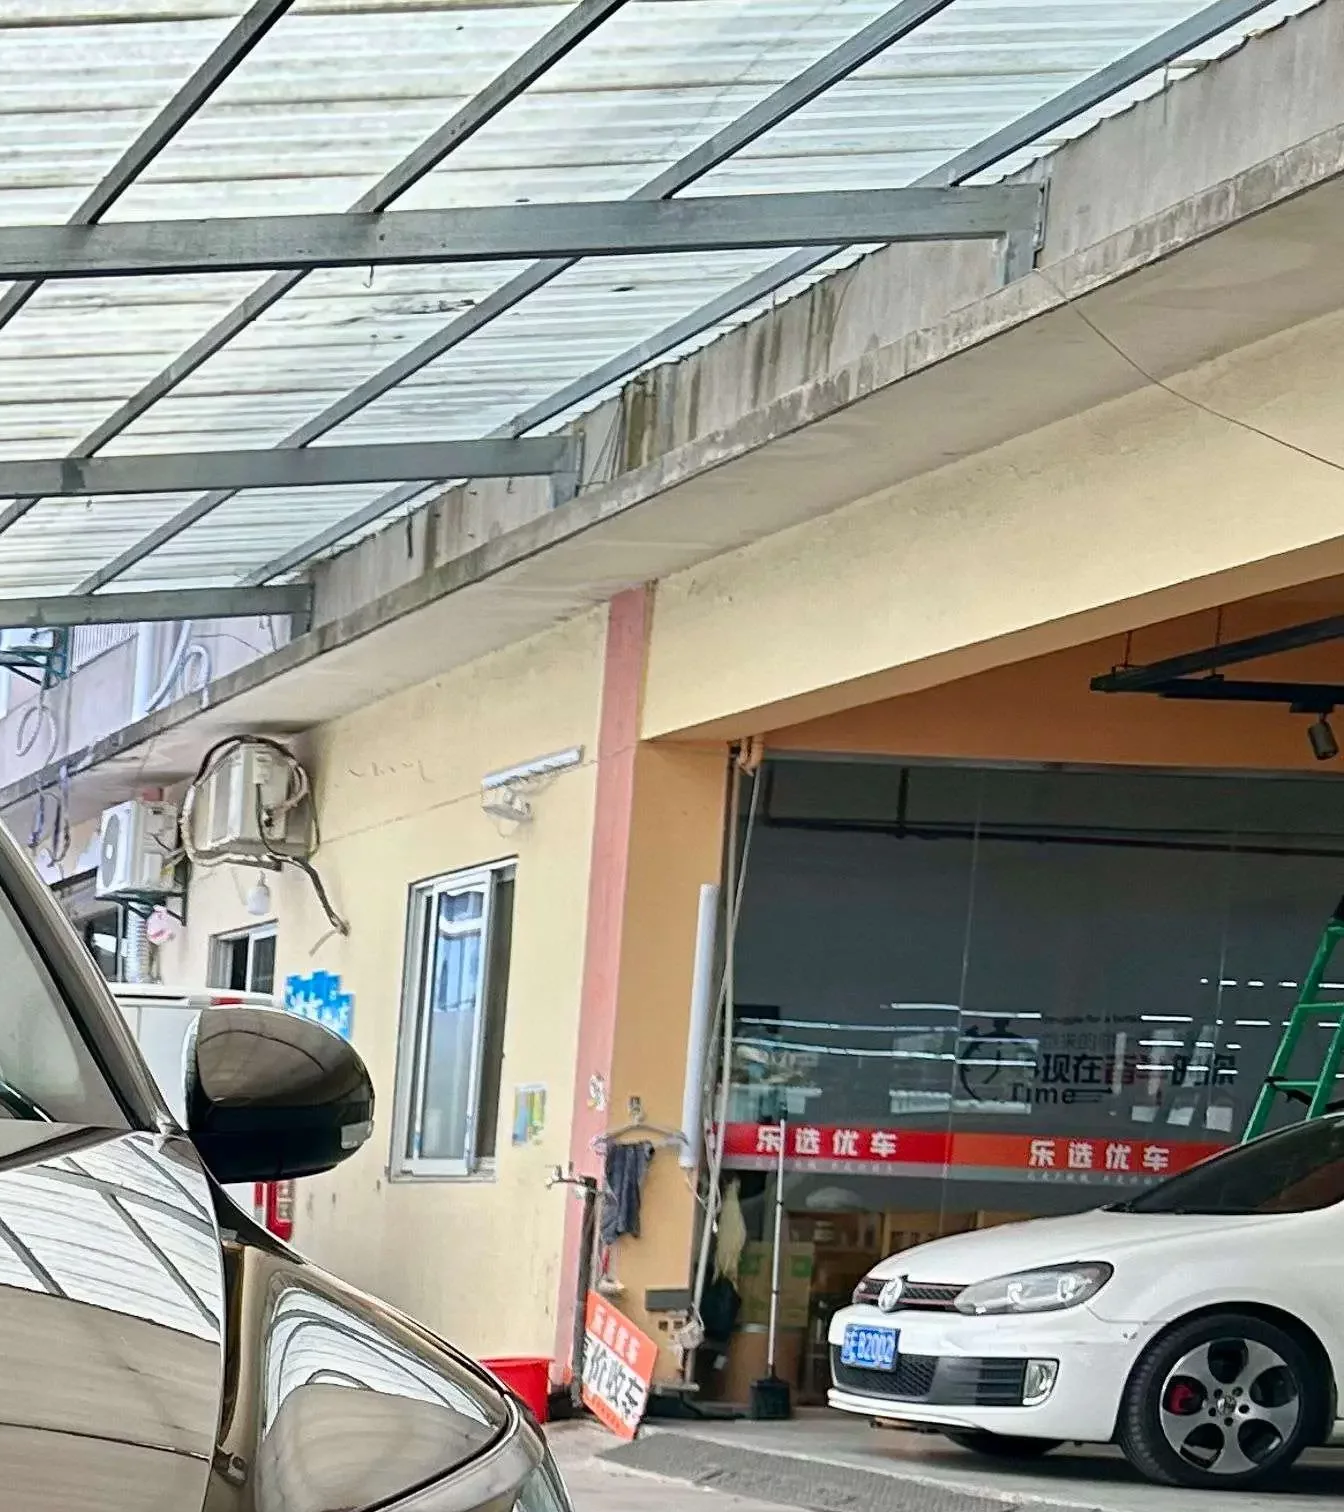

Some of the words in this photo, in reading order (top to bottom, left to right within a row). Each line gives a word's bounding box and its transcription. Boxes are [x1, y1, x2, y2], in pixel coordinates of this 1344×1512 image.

[755, 1123, 899, 1159] 乐选优车
[1027, 1138, 1170, 1172] 乐选优车
